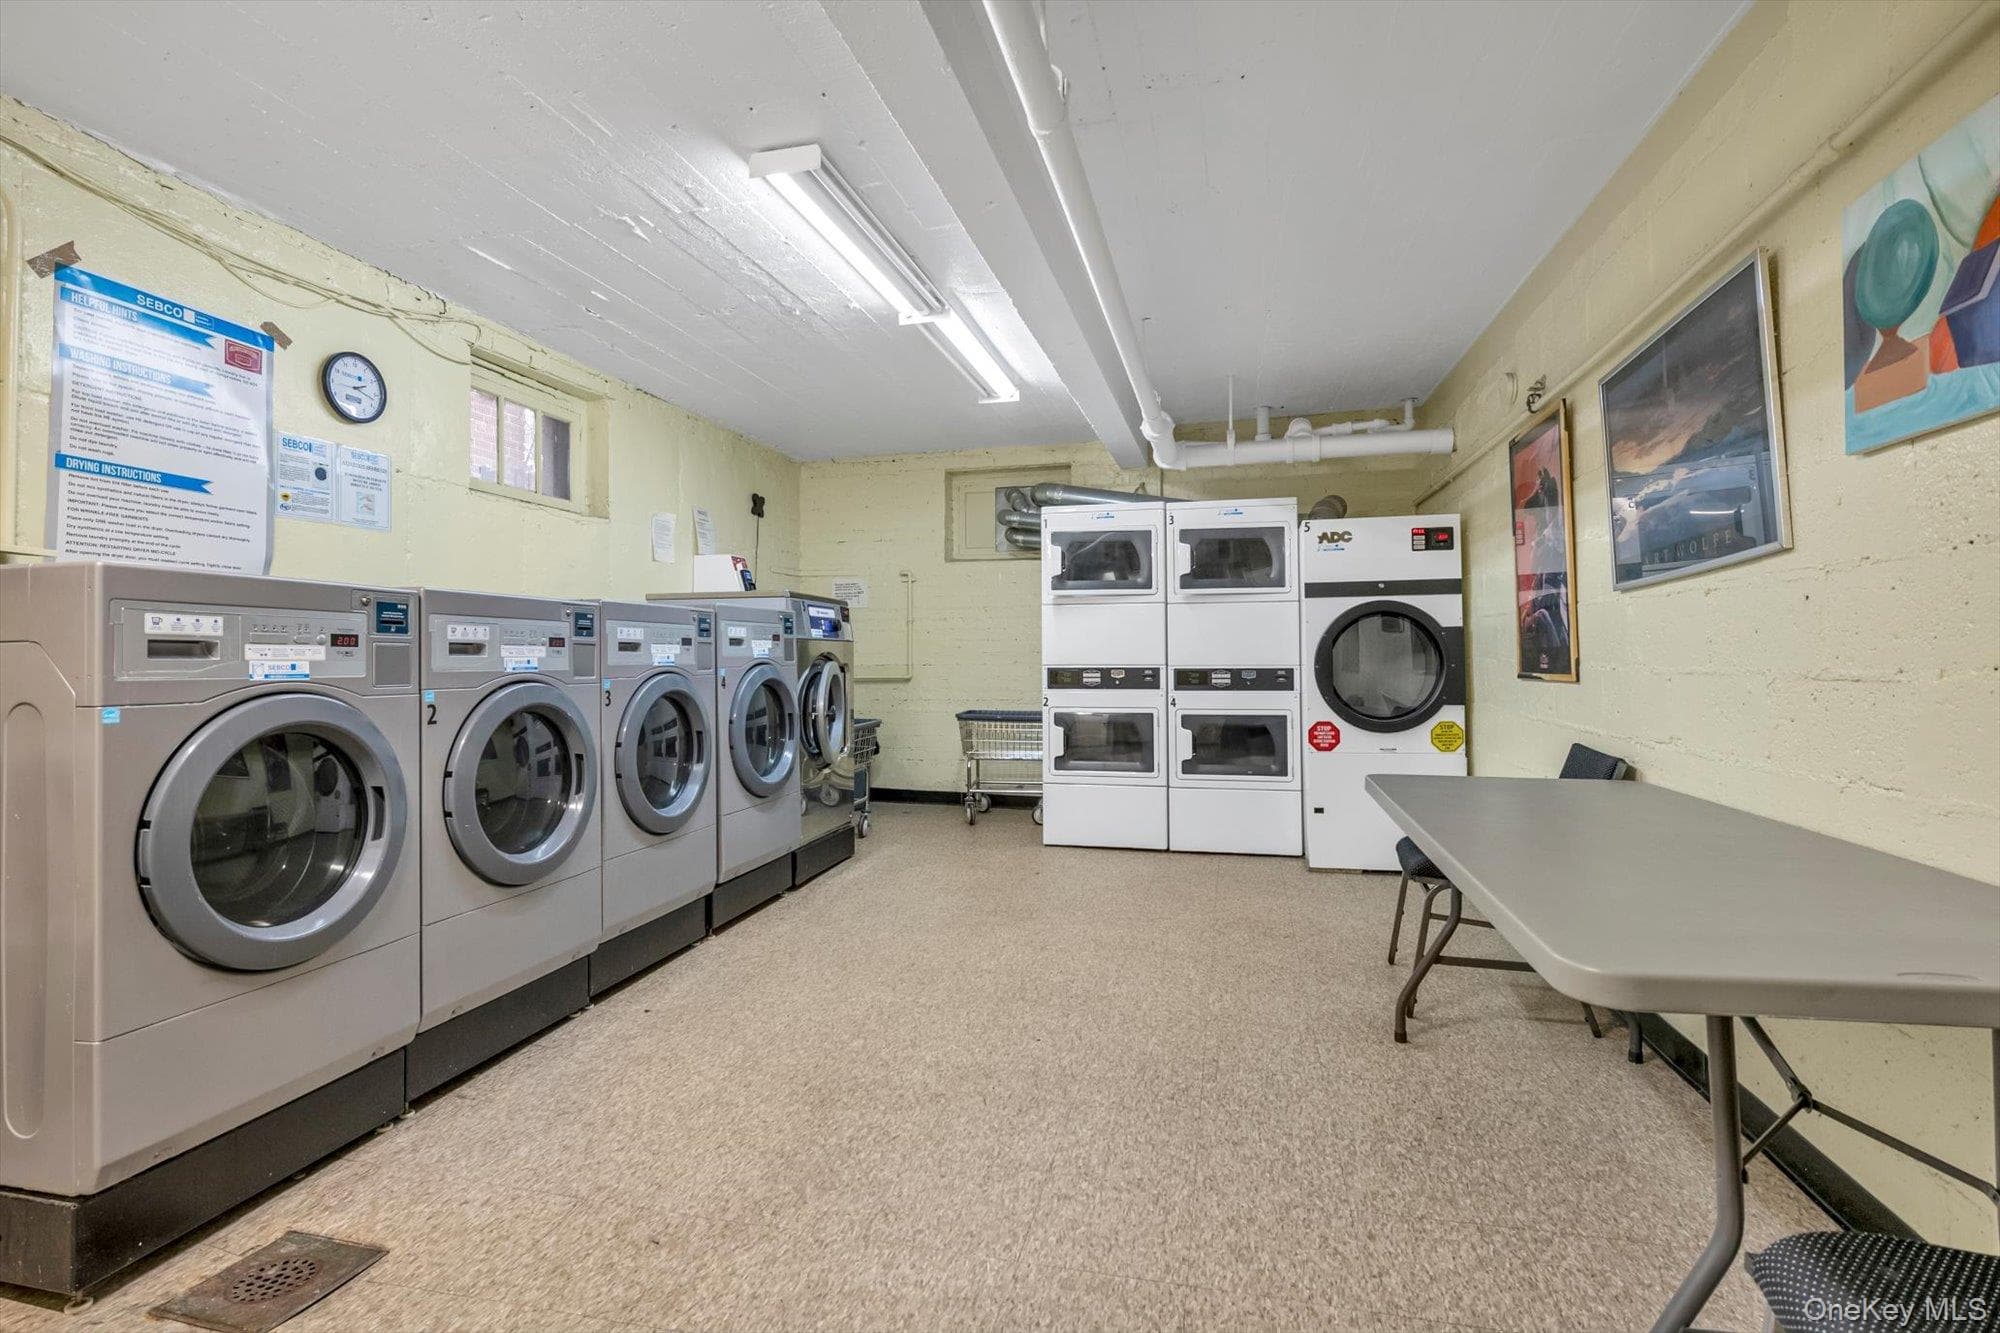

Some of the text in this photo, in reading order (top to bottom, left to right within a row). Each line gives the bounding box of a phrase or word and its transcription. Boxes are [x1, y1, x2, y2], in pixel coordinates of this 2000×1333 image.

[71, 292, 138, 322] HELPFUL HINTS
[137, 293, 182, 318] SEBCO
[70, 348, 111, 368] WASHING
[113, 358, 171, 384] INSTRUCTIONS
[282, 437, 309, 451] SEBCO
[66, 457, 162, 483] DRYING INSTRUCTIONS
[1043, 519, 1047, 528] 1
[1169, 515, 1174, 525] 3
[1304, 521, 1310, 532] 5
[1319, 531, 1353, 543] ADC
[1676, 530, 1732, 557] WOLFE
[337, 636, 356, 645] 200
[720, 676, 726, 689] 4
[605, 691, 611, 706] 3
[1043, 697, 1049, 707] 2
[1170, 698, 1176, 707] 4
[427, 704, 437, 725] 2
